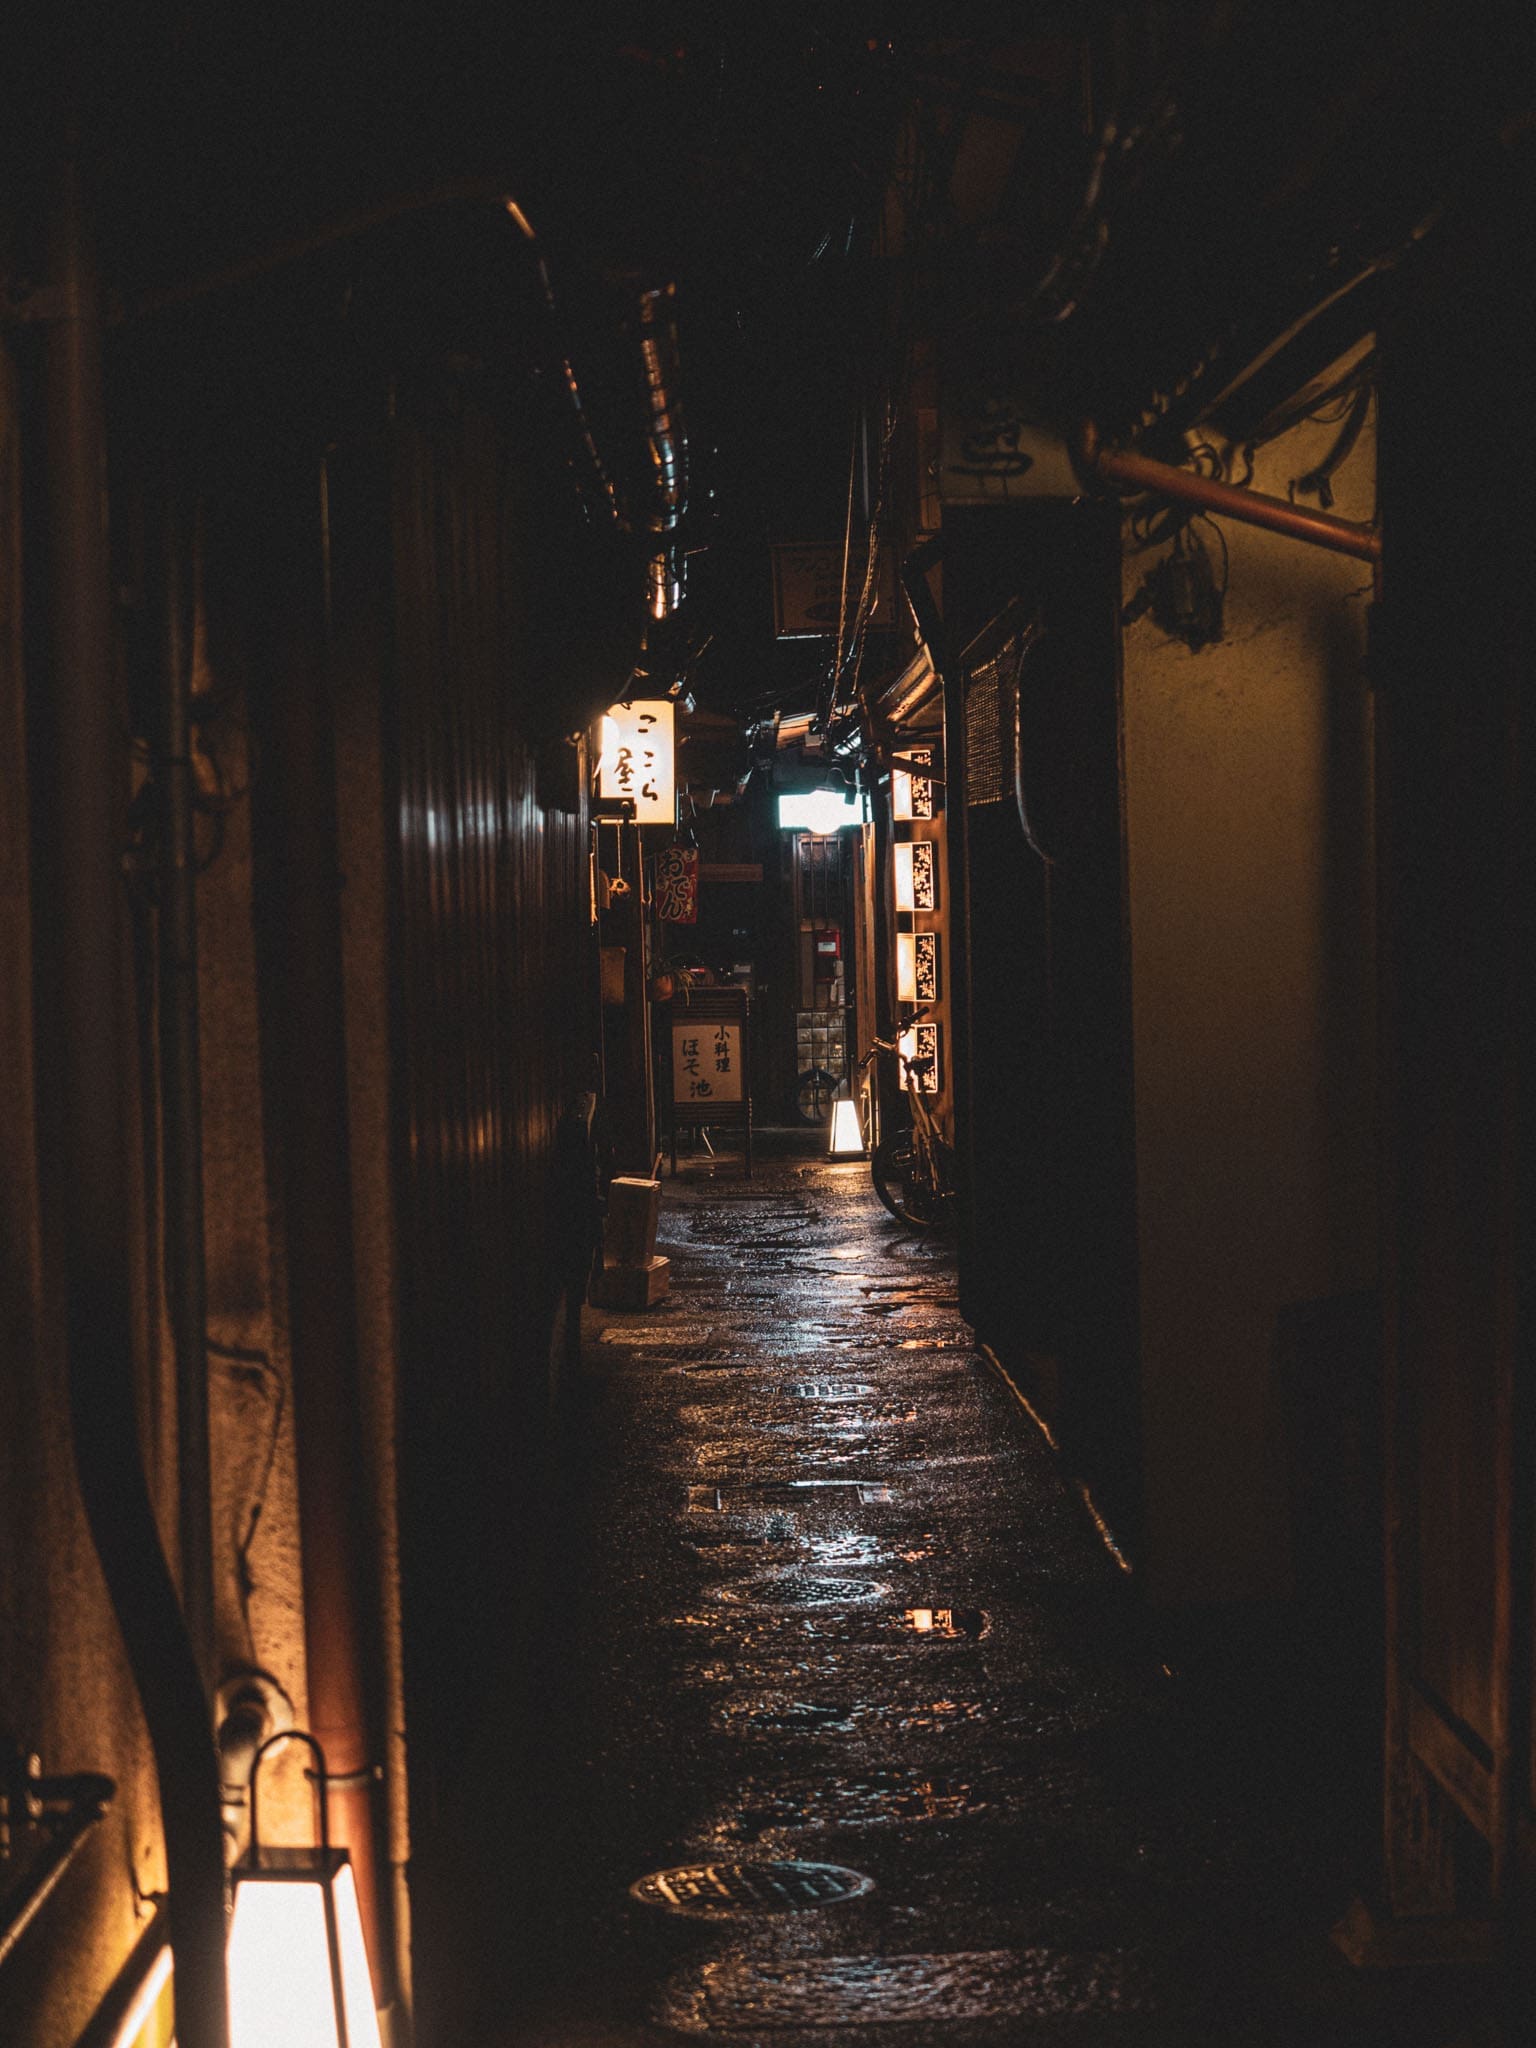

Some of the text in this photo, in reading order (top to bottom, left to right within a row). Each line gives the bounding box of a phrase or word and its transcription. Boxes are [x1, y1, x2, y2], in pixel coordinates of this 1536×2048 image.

[659, 849, 688, 919] おでん
[682, 1039, 713, 1097] ほそ池
[714, 1025, 731, 1073] 小料理
